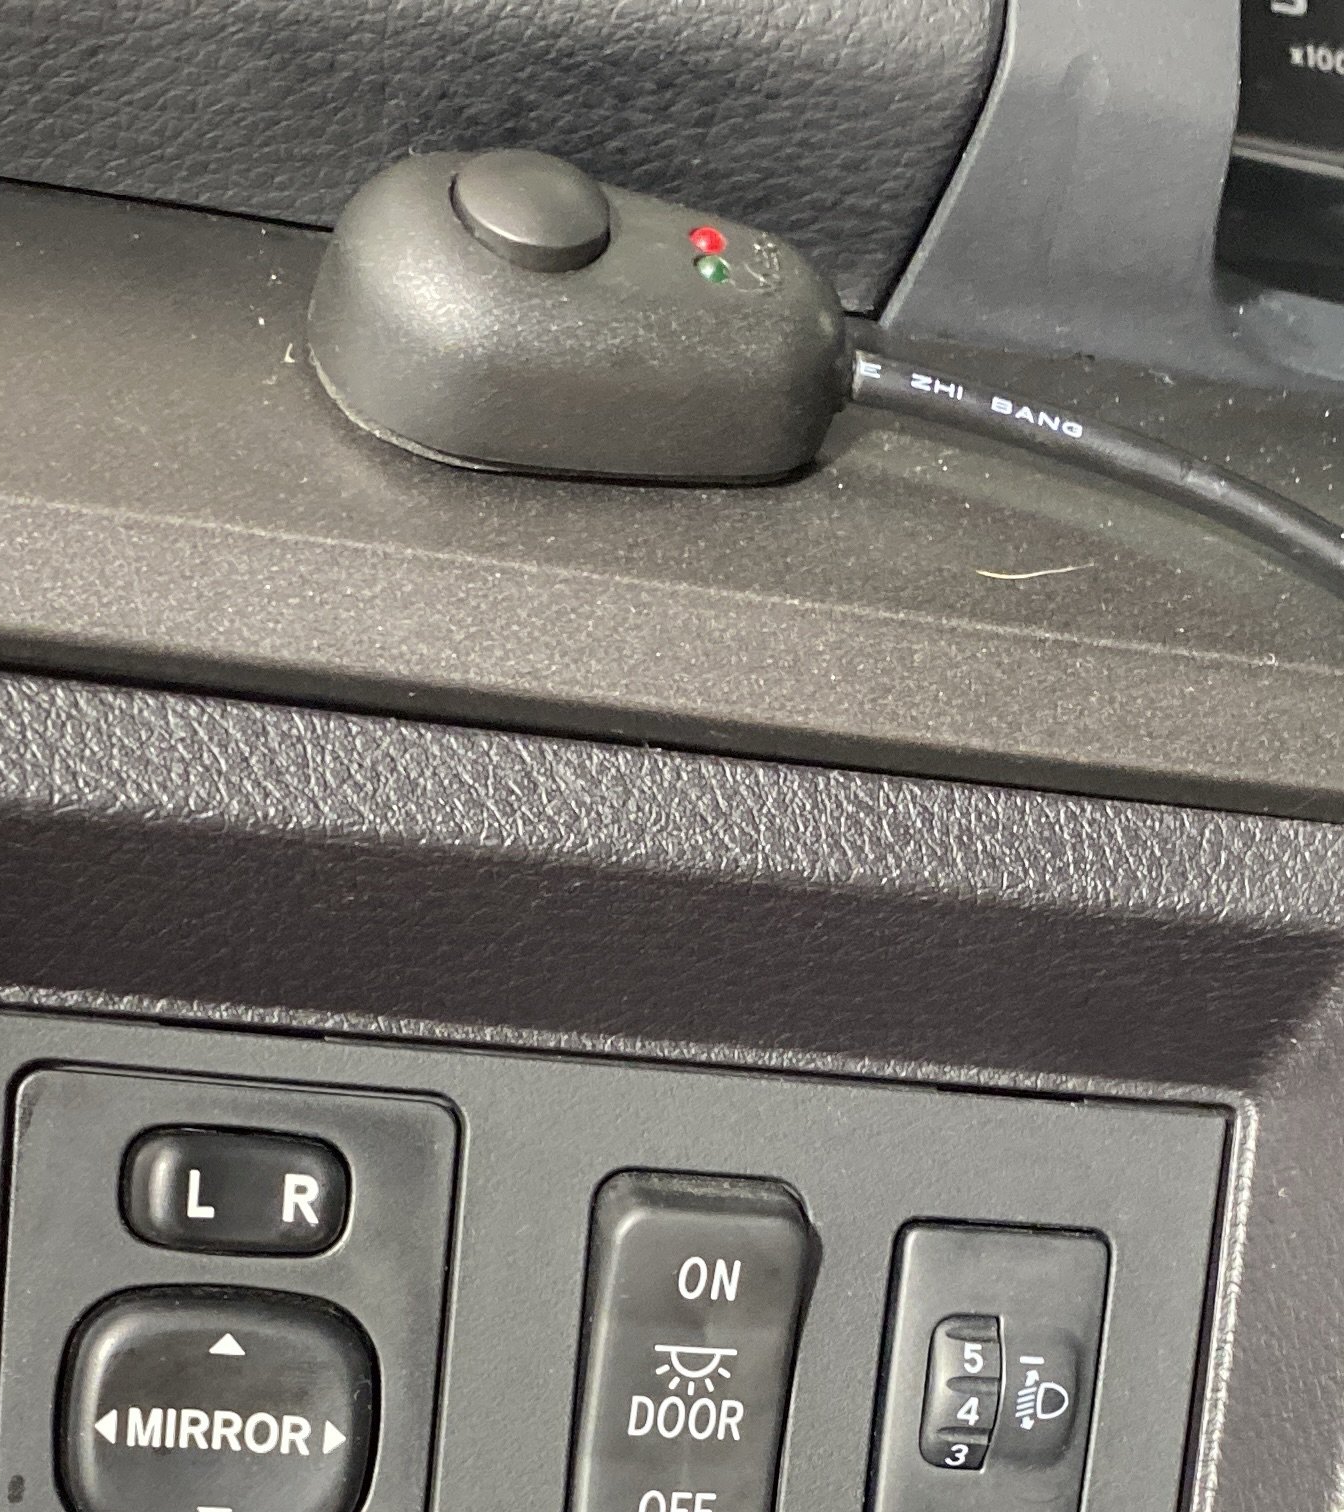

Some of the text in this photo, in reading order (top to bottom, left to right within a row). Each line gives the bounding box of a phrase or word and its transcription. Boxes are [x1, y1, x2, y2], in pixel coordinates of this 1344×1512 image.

[910, 372, 964, 401] ZHI
[991, 396, 1083, 439] BANG
[187, 1169, 320, 1225] L R
[677, 1256, 742, 1302] ON
[963, 1342, 984, 1374] 5
[126, 1407, 311, 1456] MIRROR
[627, 1396, 744, 1441] DOOR
[956, 1396, 980, 1426] 4
[944, 1443, 969, 1466] 3
